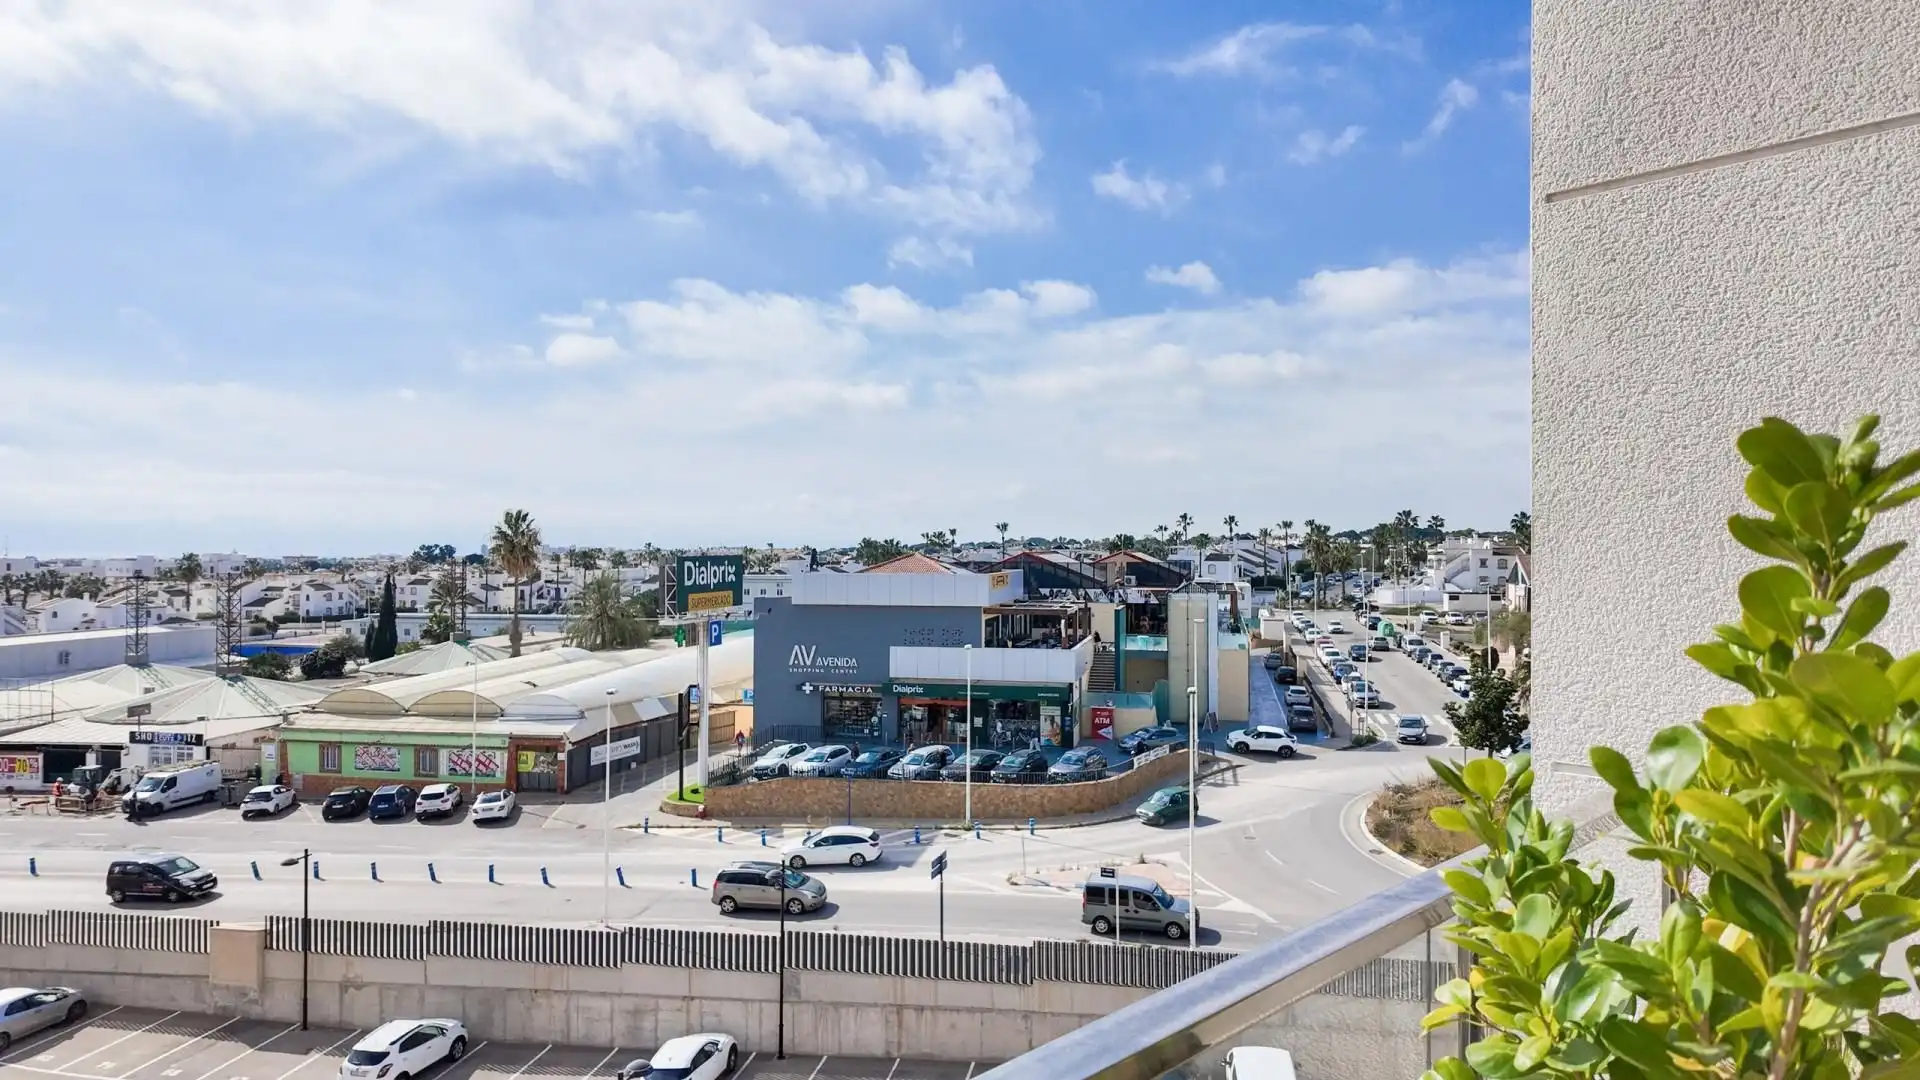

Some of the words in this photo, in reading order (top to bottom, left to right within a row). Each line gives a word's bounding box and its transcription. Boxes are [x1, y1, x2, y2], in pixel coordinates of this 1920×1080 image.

[684, 560, 736, 589] Dialprix
[691, 594, 731, 608] SUPERMERCADO
[711, 624, 719, 643] P
[788, 644, 817, 666] AV
[816, 657, 858, 667] AVENIDA
[818, 685, 873, 694] FARMACIA
[892, 684, 924, 694] Dialprix
[1094, 717, 1111, 725] ATM
